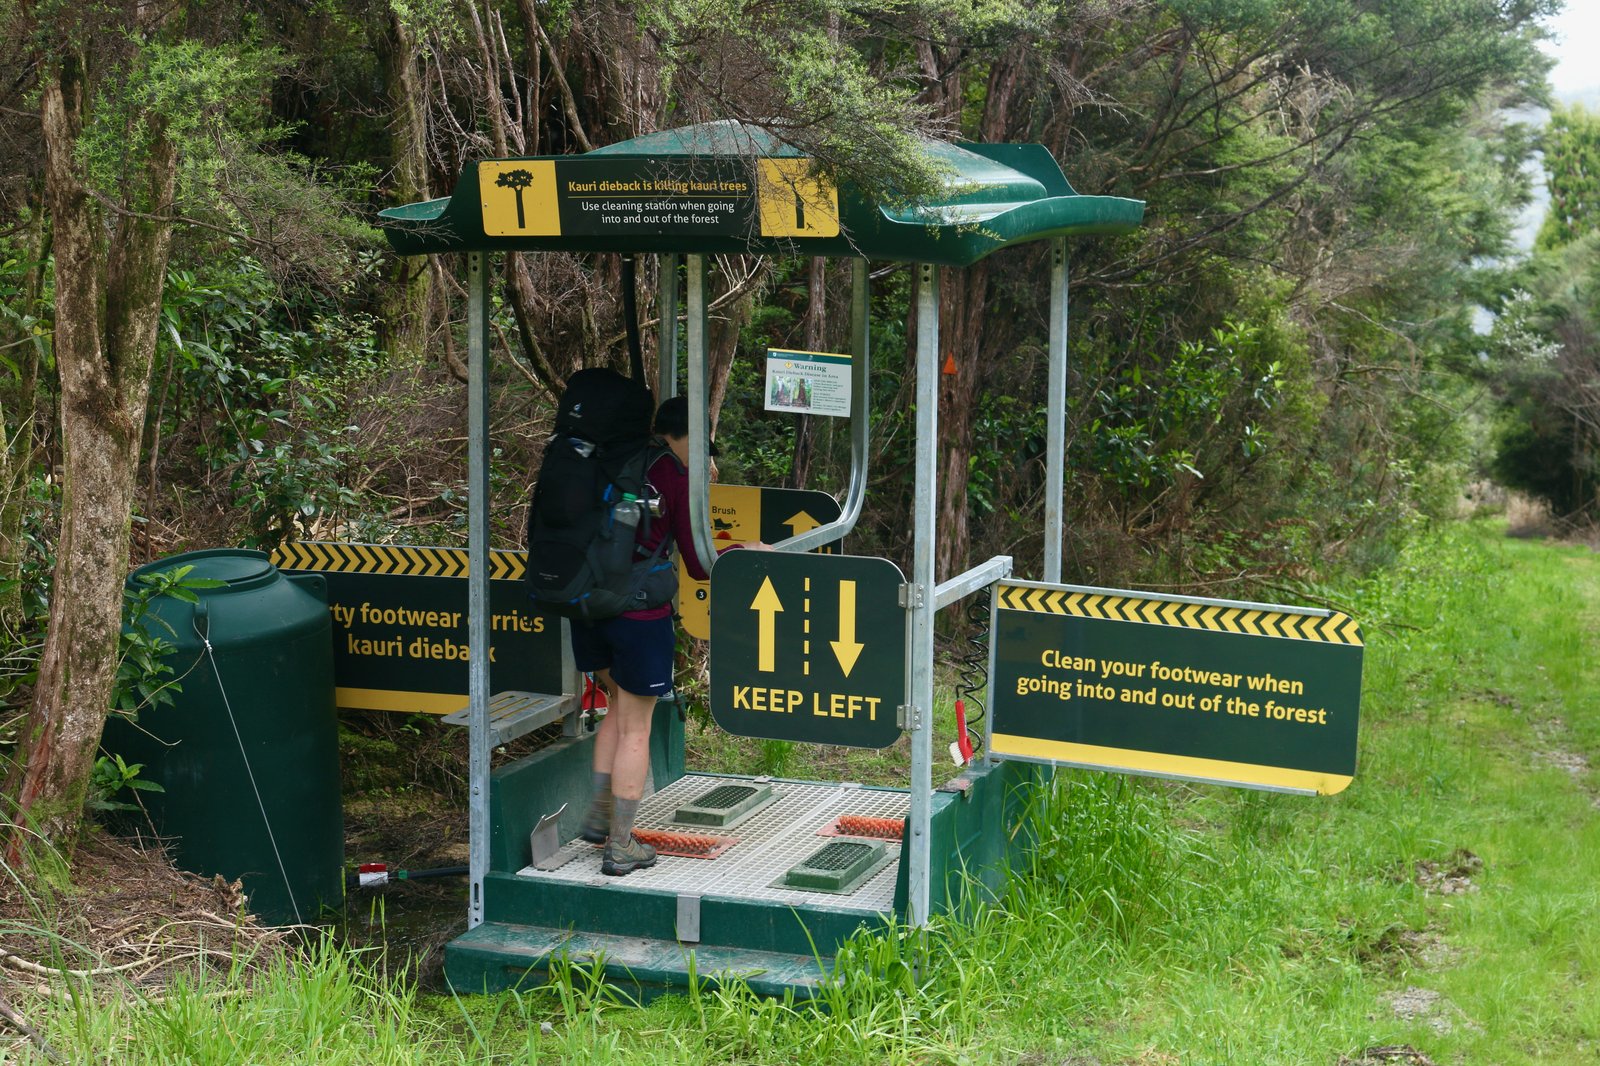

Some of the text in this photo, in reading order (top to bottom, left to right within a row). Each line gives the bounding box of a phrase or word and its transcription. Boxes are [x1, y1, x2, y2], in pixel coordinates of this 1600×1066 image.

[568, 180, 747, 194] Kauri dieback is killing kauri trees
[581, 200, 735, 214] Use cleaning station when going
[601, 213, 720, 224] into and out of the forest
[794, 363, 827, 373] Warning
[712, 506, 736, 515] Brush
[699, 591, 705, 599] 3
[360, 602, 462, 629] footwear
[467, 609, 545, 633] rries
[347, 633, 496, 662] kauri diebak
[1041, 649, 1304, 695] Clean your footwear when
[733, 685, 882, 721] KEEP LEFT
[1016, 675, 1327, 725] going into and out of the forest
